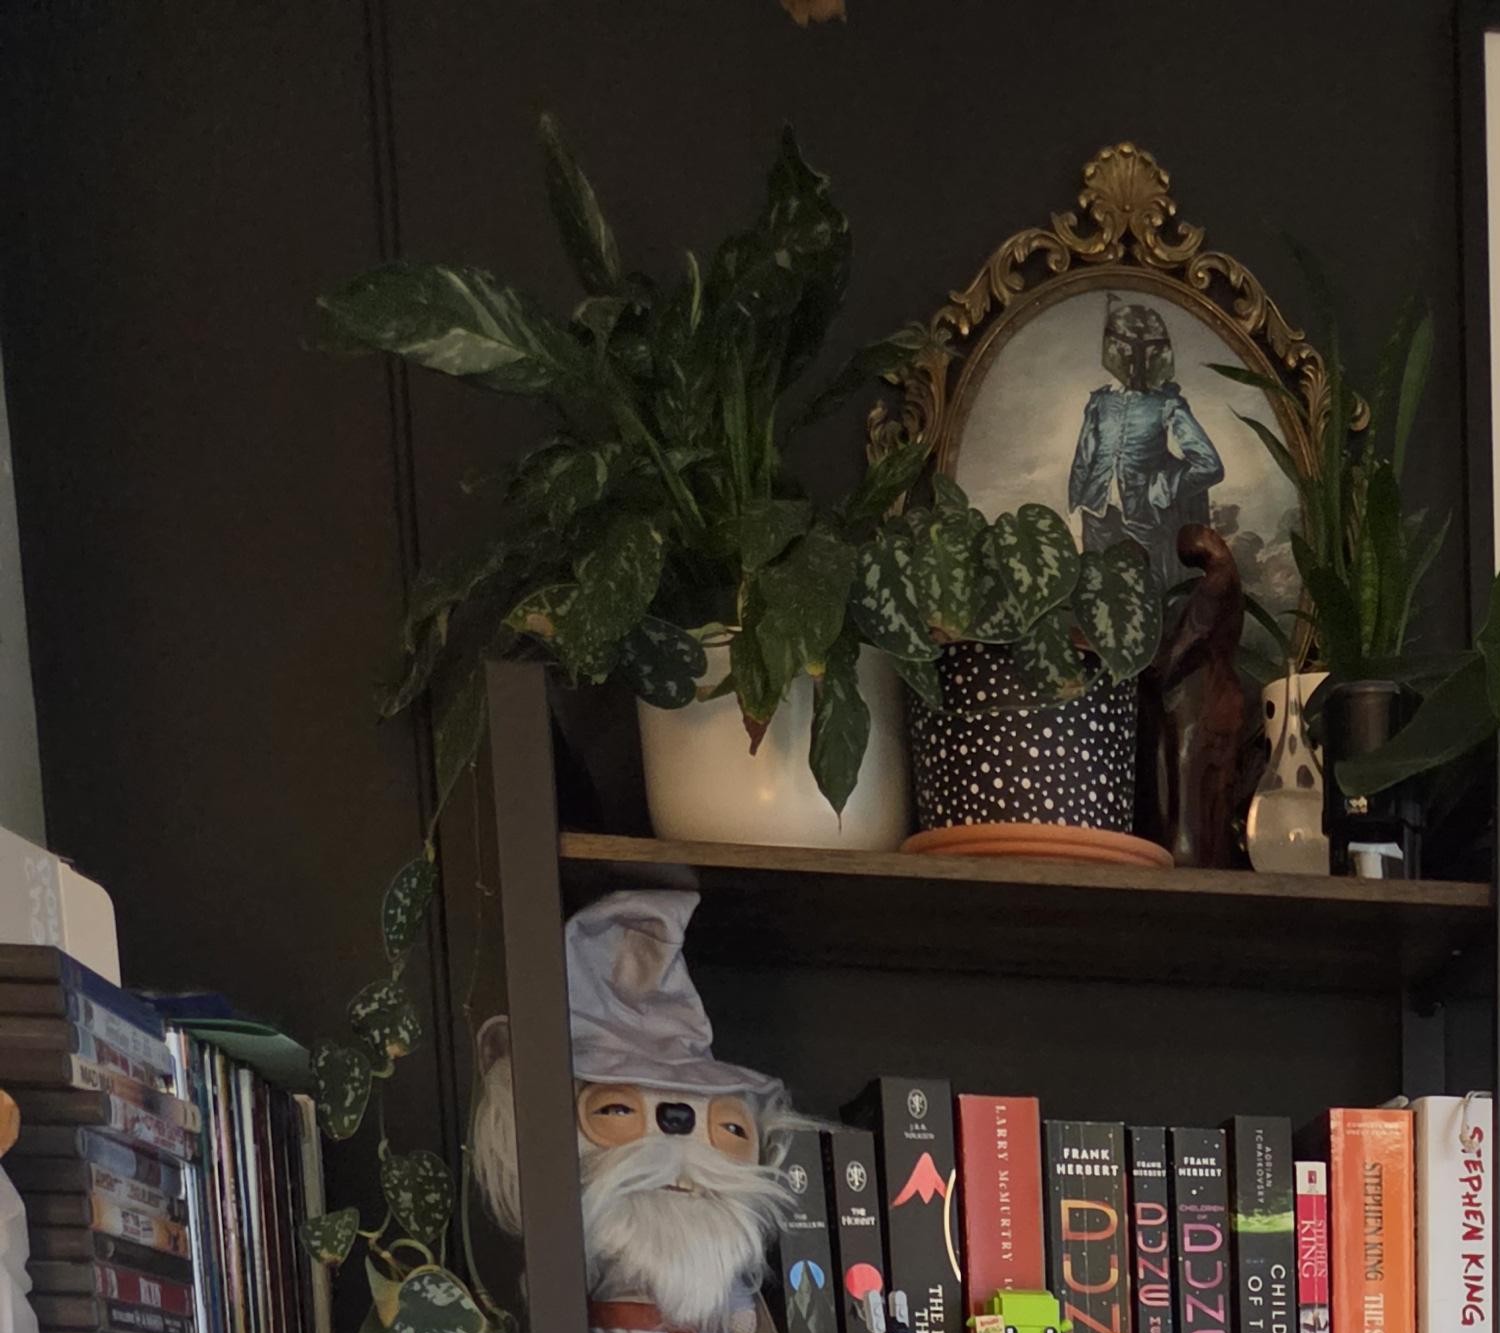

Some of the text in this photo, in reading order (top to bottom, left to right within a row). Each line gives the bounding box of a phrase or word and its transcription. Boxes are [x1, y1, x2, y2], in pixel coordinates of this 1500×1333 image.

[1056, 1162, 1119, 1177] HERBERT
[1063, 1148, 1110, 1160] FRANK
[995, 1105, 1014, 1261] LARRY McMURTRY
[1364, 1162, 1383, 1236] STEPHEN
[1458, 1124, 1485, 1327] STEPHEN KING
[1135, 1202, 1169, 1308] DUNE
[1365, 1242, 1384, 1282] KING
[928, 1284, 944, 1323] THE
[1248, 1276, 1263, 1314] OF
[1364, 1293, 1384, 1326] THE
